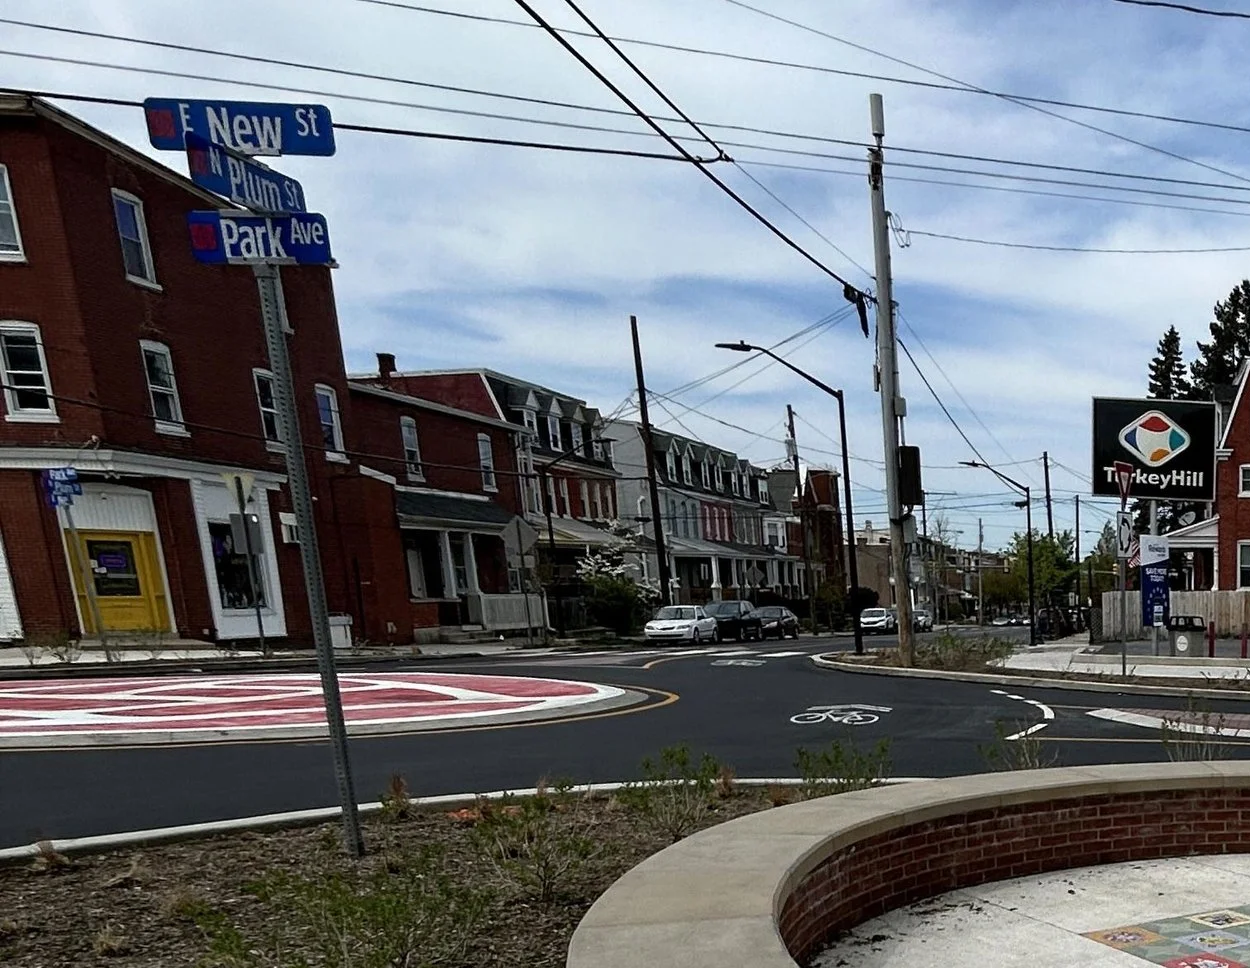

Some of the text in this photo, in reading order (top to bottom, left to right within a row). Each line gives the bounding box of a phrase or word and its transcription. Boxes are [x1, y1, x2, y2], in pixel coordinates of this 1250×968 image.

[178, 102, 320, 149] E New St
[209, 146, 299, 212] N Plum St
[220, 218, 325, 258] Park Ave
